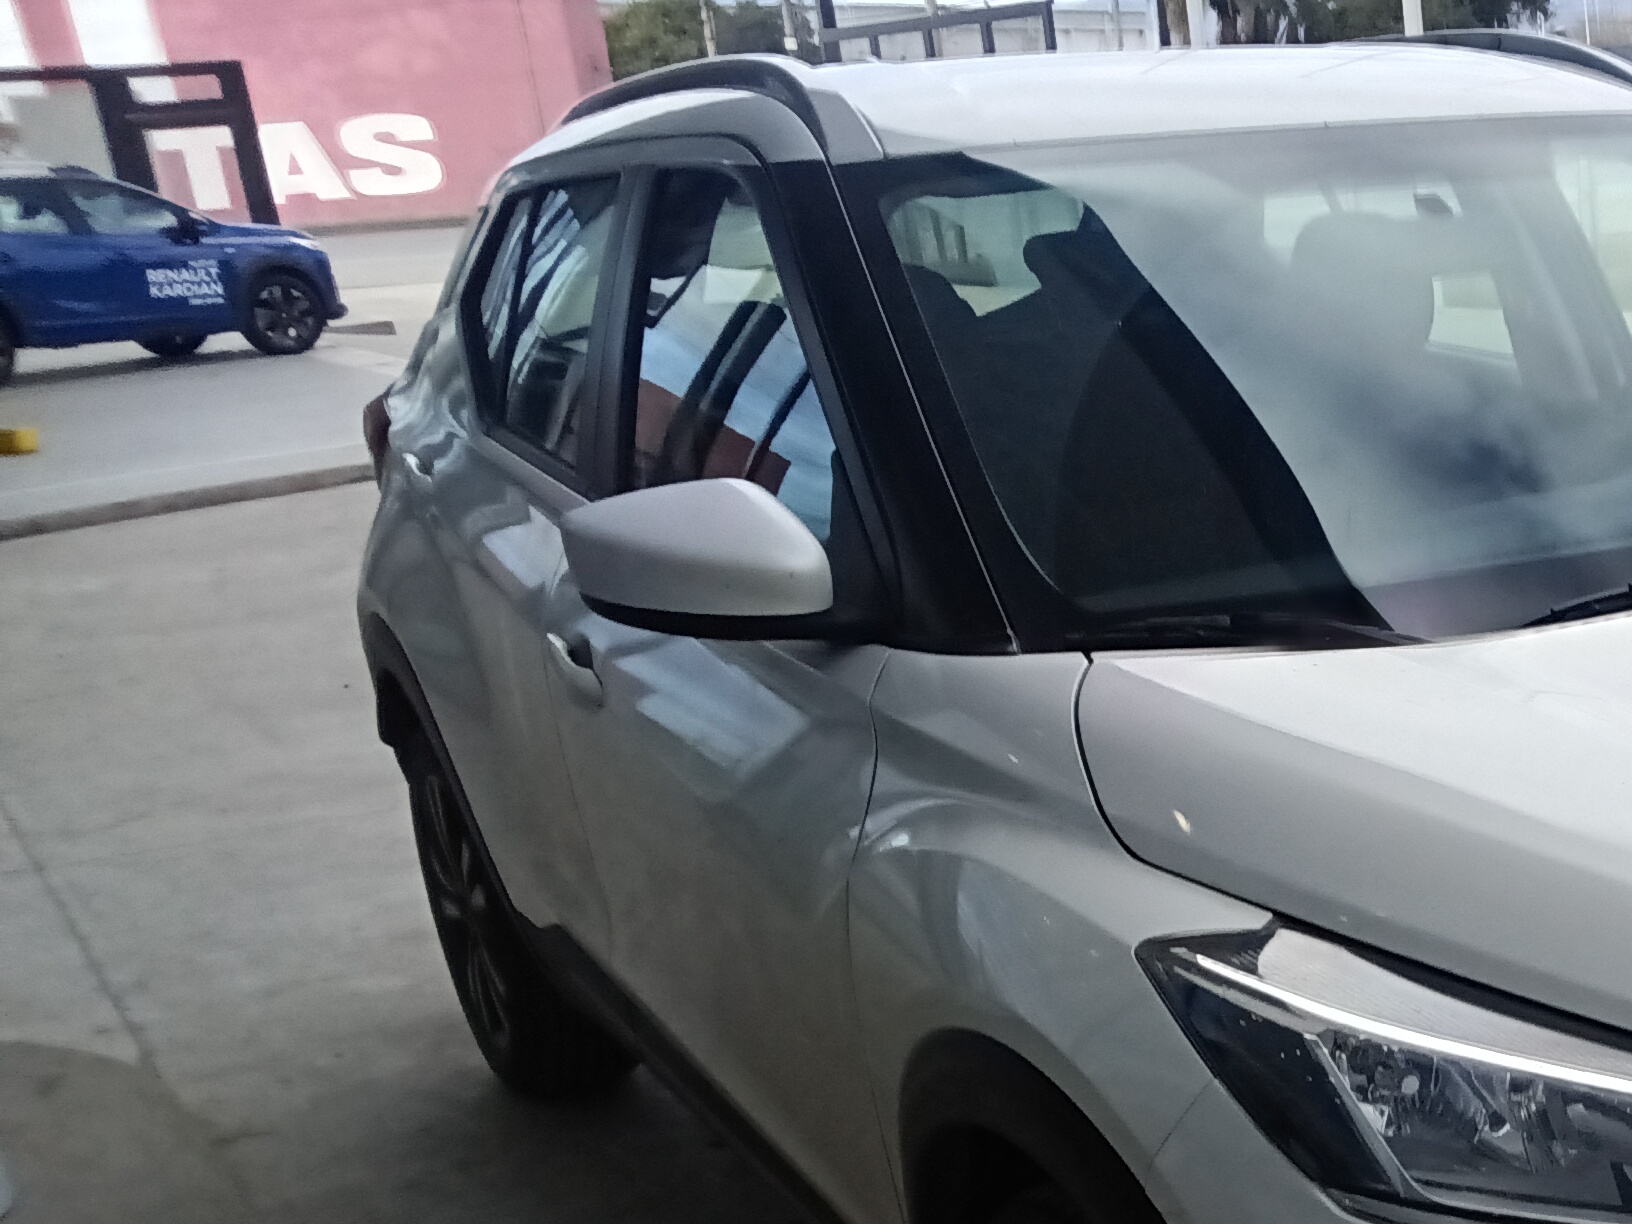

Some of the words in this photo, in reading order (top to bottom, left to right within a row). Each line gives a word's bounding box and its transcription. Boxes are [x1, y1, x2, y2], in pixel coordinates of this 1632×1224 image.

[144, 112, 444, 211] TAS
[145, 267, 221, 282] RENAULT
[149, 281, 225, 298] KARDIAN
